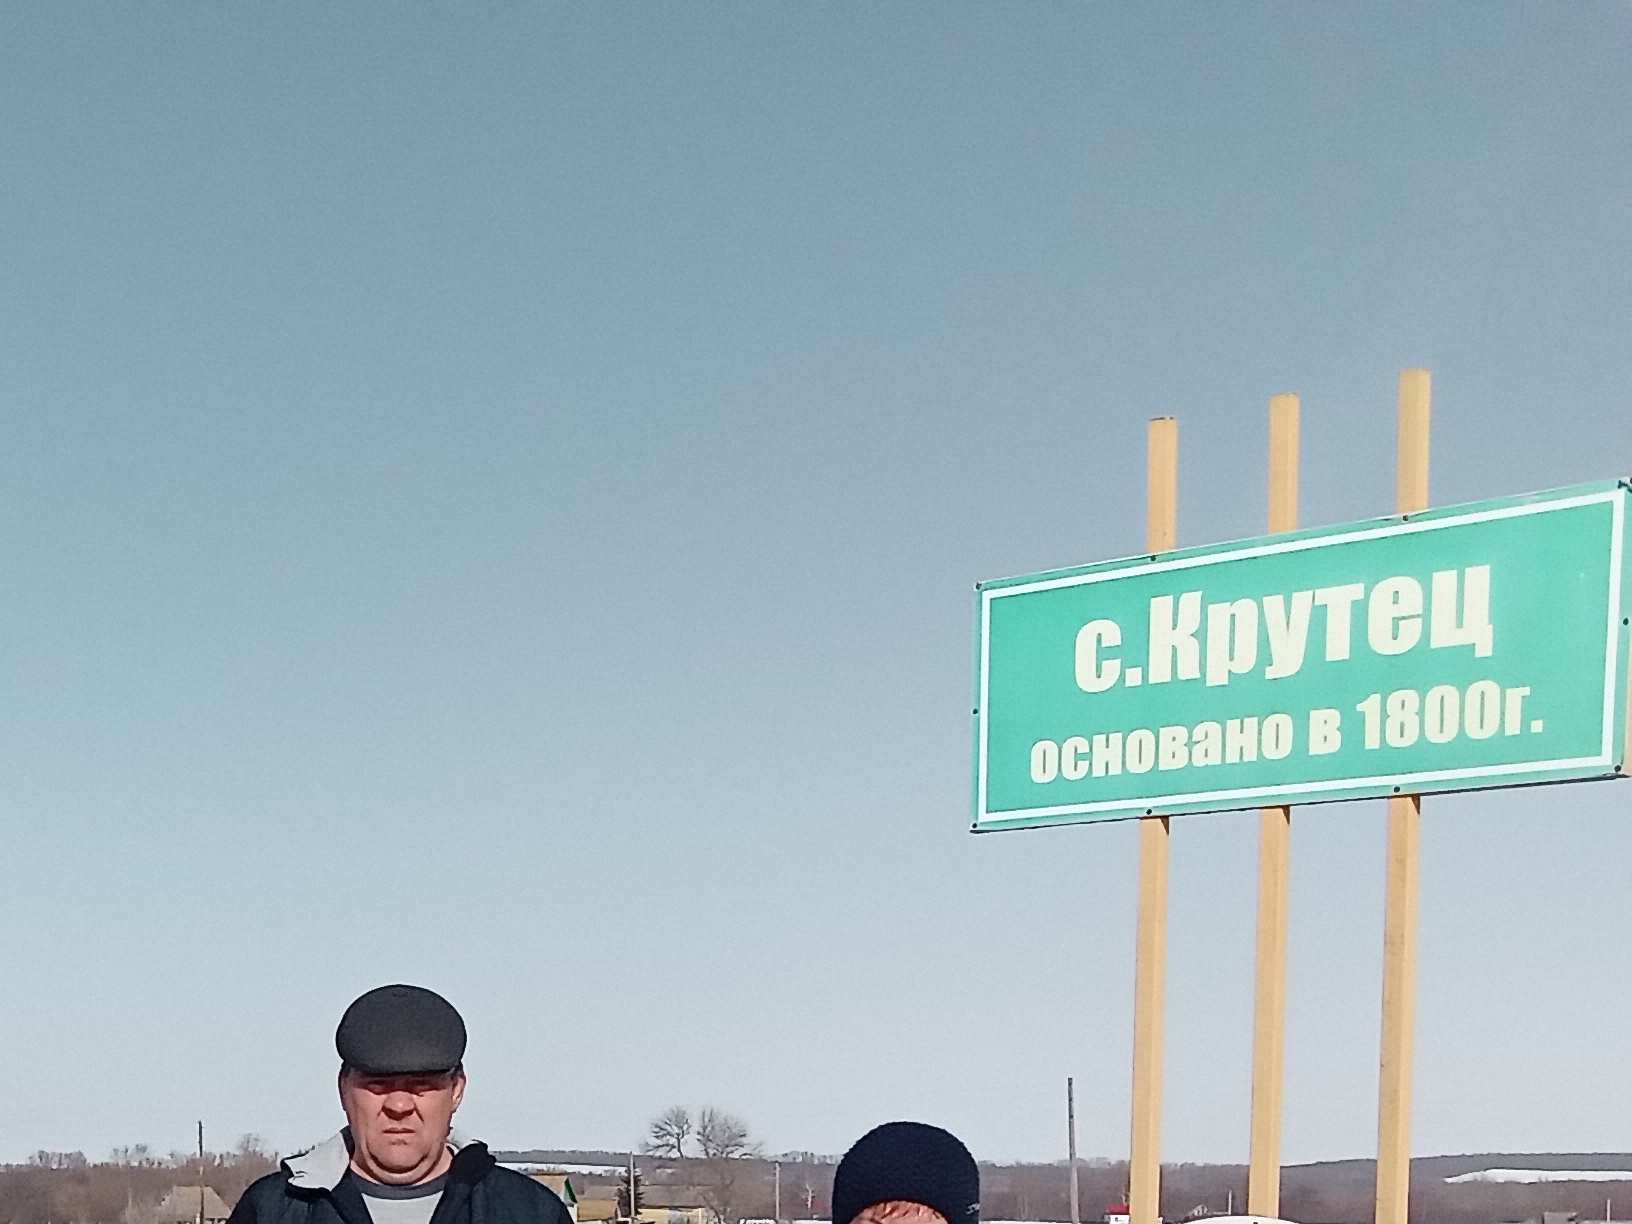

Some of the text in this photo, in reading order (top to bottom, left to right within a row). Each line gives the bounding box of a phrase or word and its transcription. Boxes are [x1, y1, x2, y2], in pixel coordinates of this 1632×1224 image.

[1074, 565, 1494, 694] с.Крутец
[1029, 679, 1544, 784] основано в 1800г.
